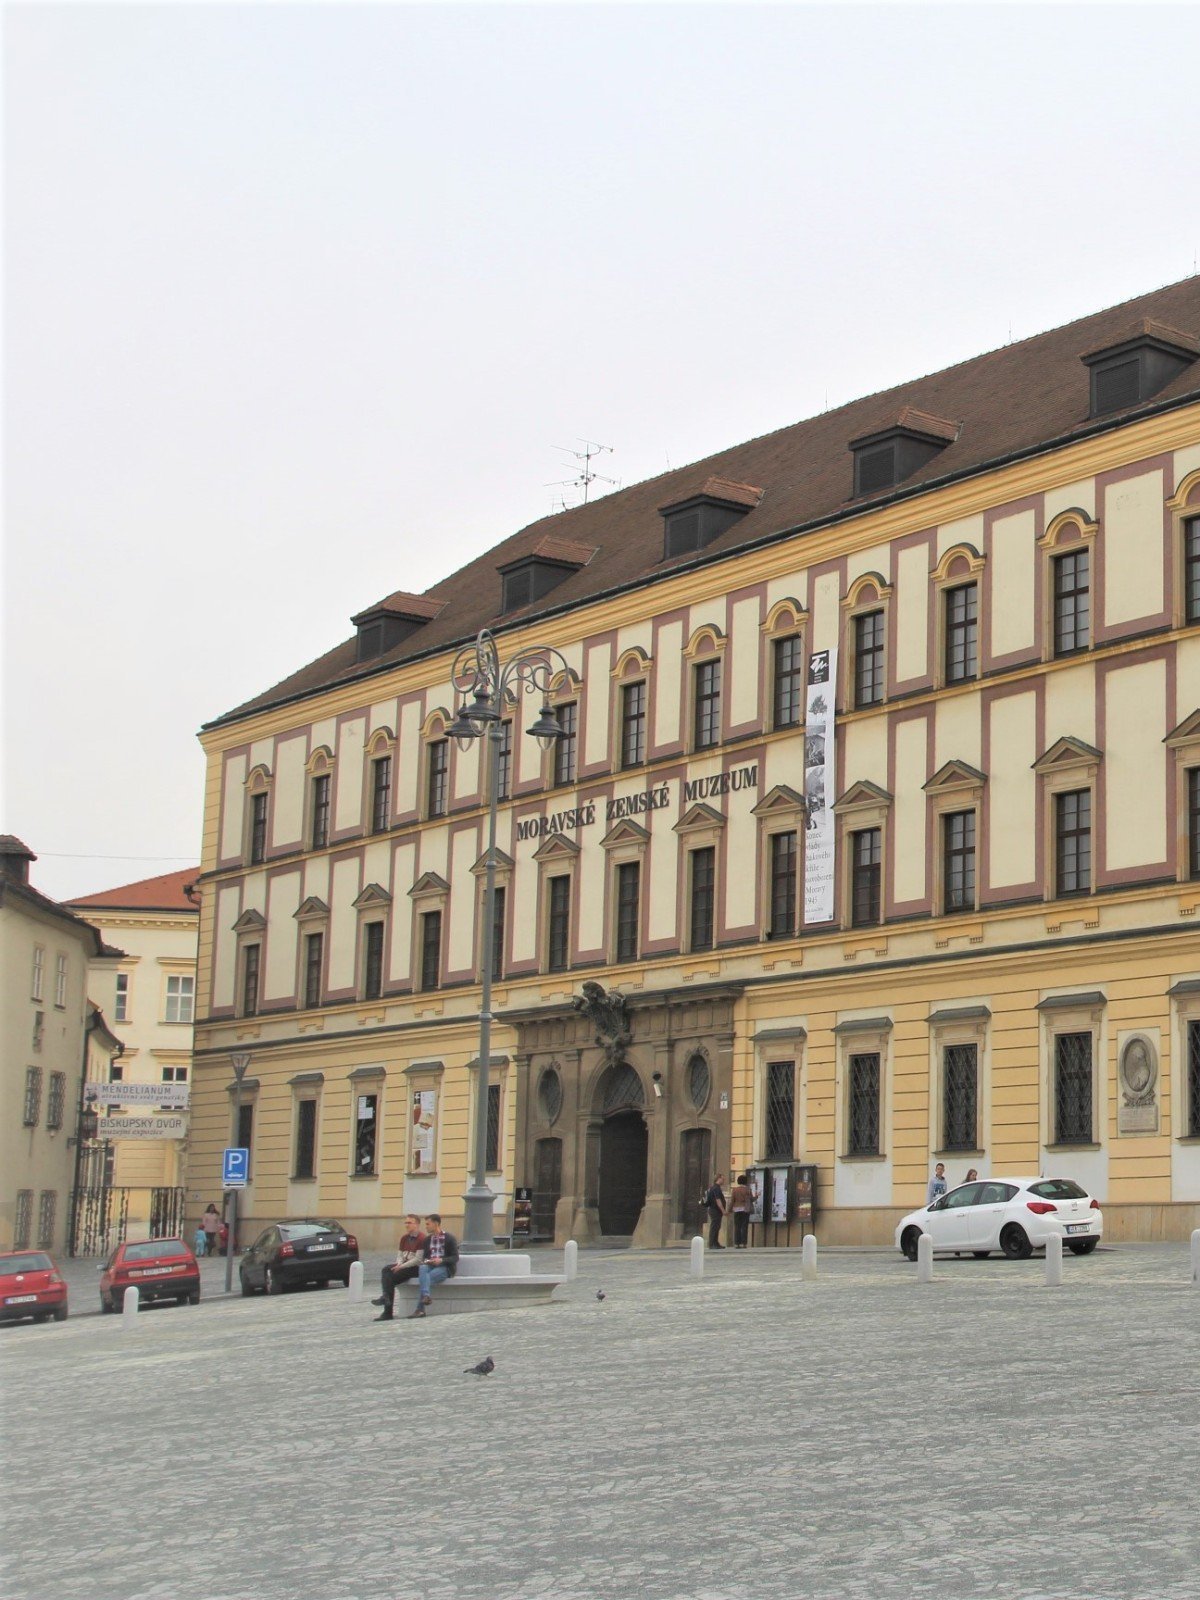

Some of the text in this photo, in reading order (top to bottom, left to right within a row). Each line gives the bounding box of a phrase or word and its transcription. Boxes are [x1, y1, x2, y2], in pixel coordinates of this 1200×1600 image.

[516, 766, 758, 842] MORAVSKÉ ZEMSKÉ MUZEUM
[102, 1086, 171, 1094] MENDELIANUM
[228, 1152, 243, 1171] P
